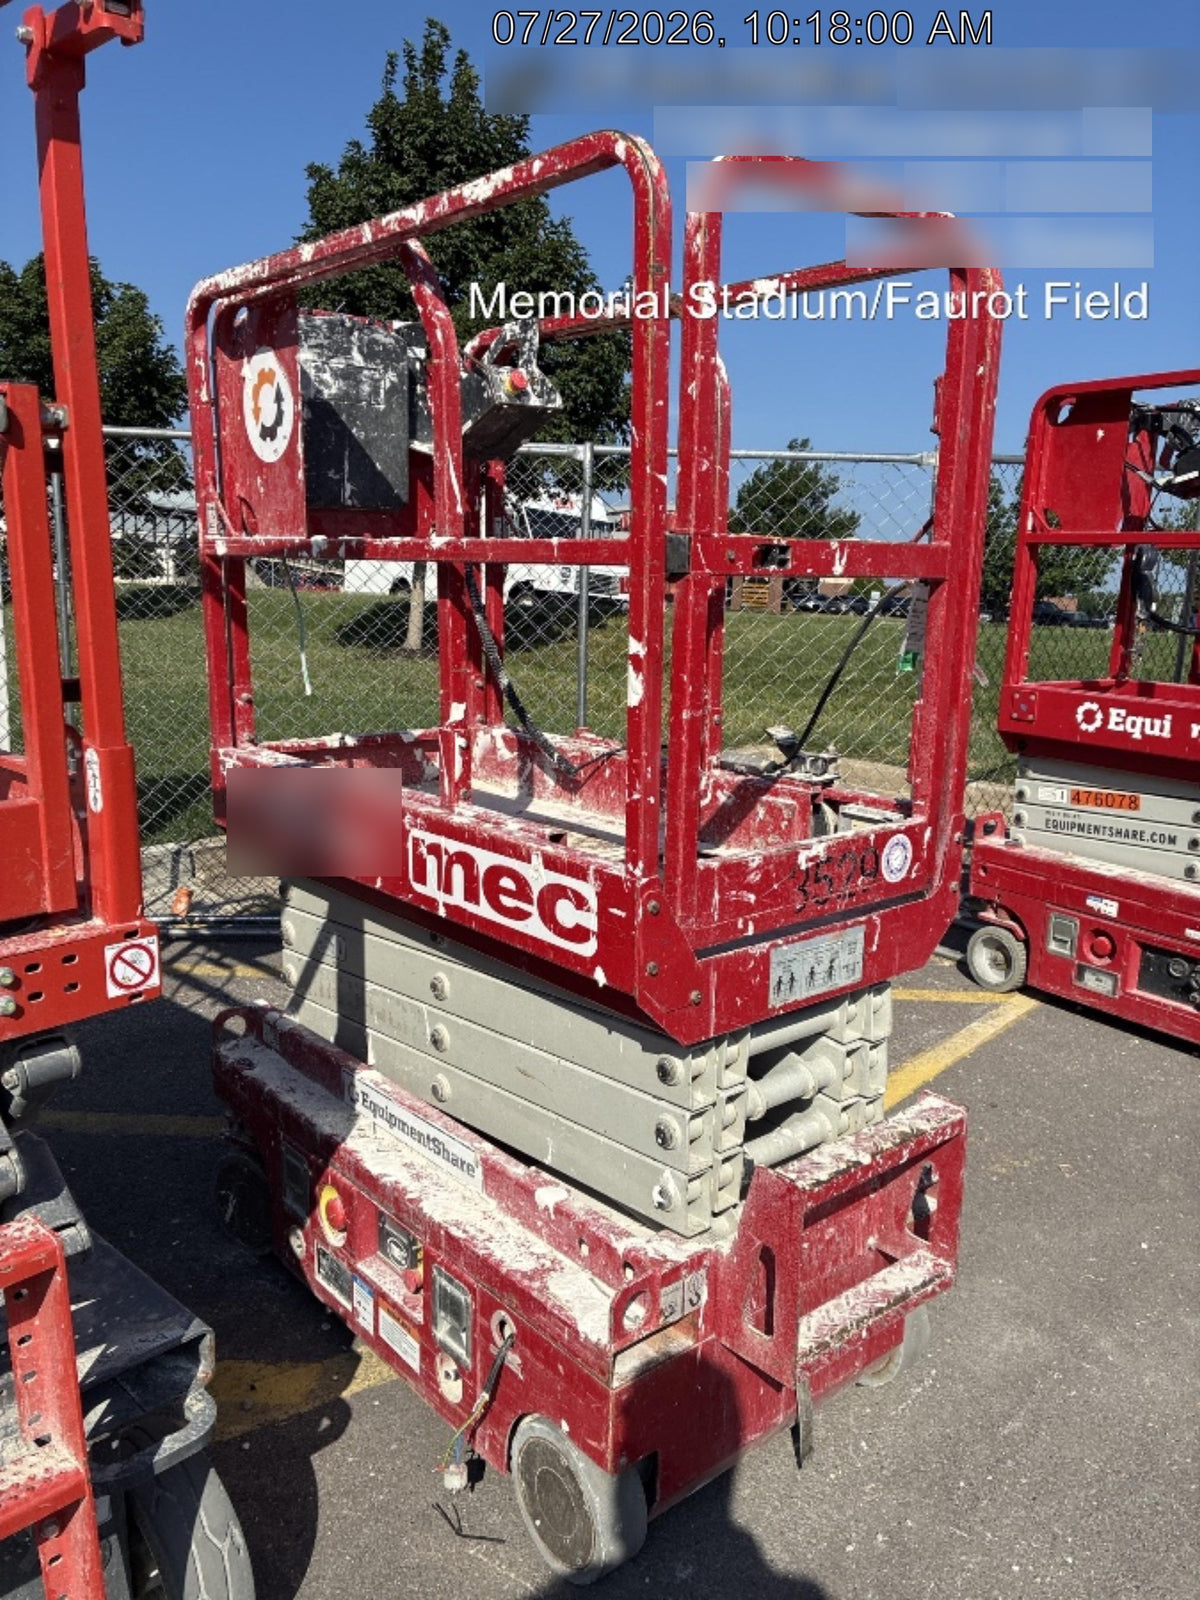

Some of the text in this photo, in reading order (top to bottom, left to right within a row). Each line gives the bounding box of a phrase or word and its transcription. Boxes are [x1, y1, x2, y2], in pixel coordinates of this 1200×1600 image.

[1045, 819, 1177, 846] EQUIPMENTSHARE.COM
[411, 836, 592, 945] mec
[360, 1090, 477, 1178] EquipmentShare
